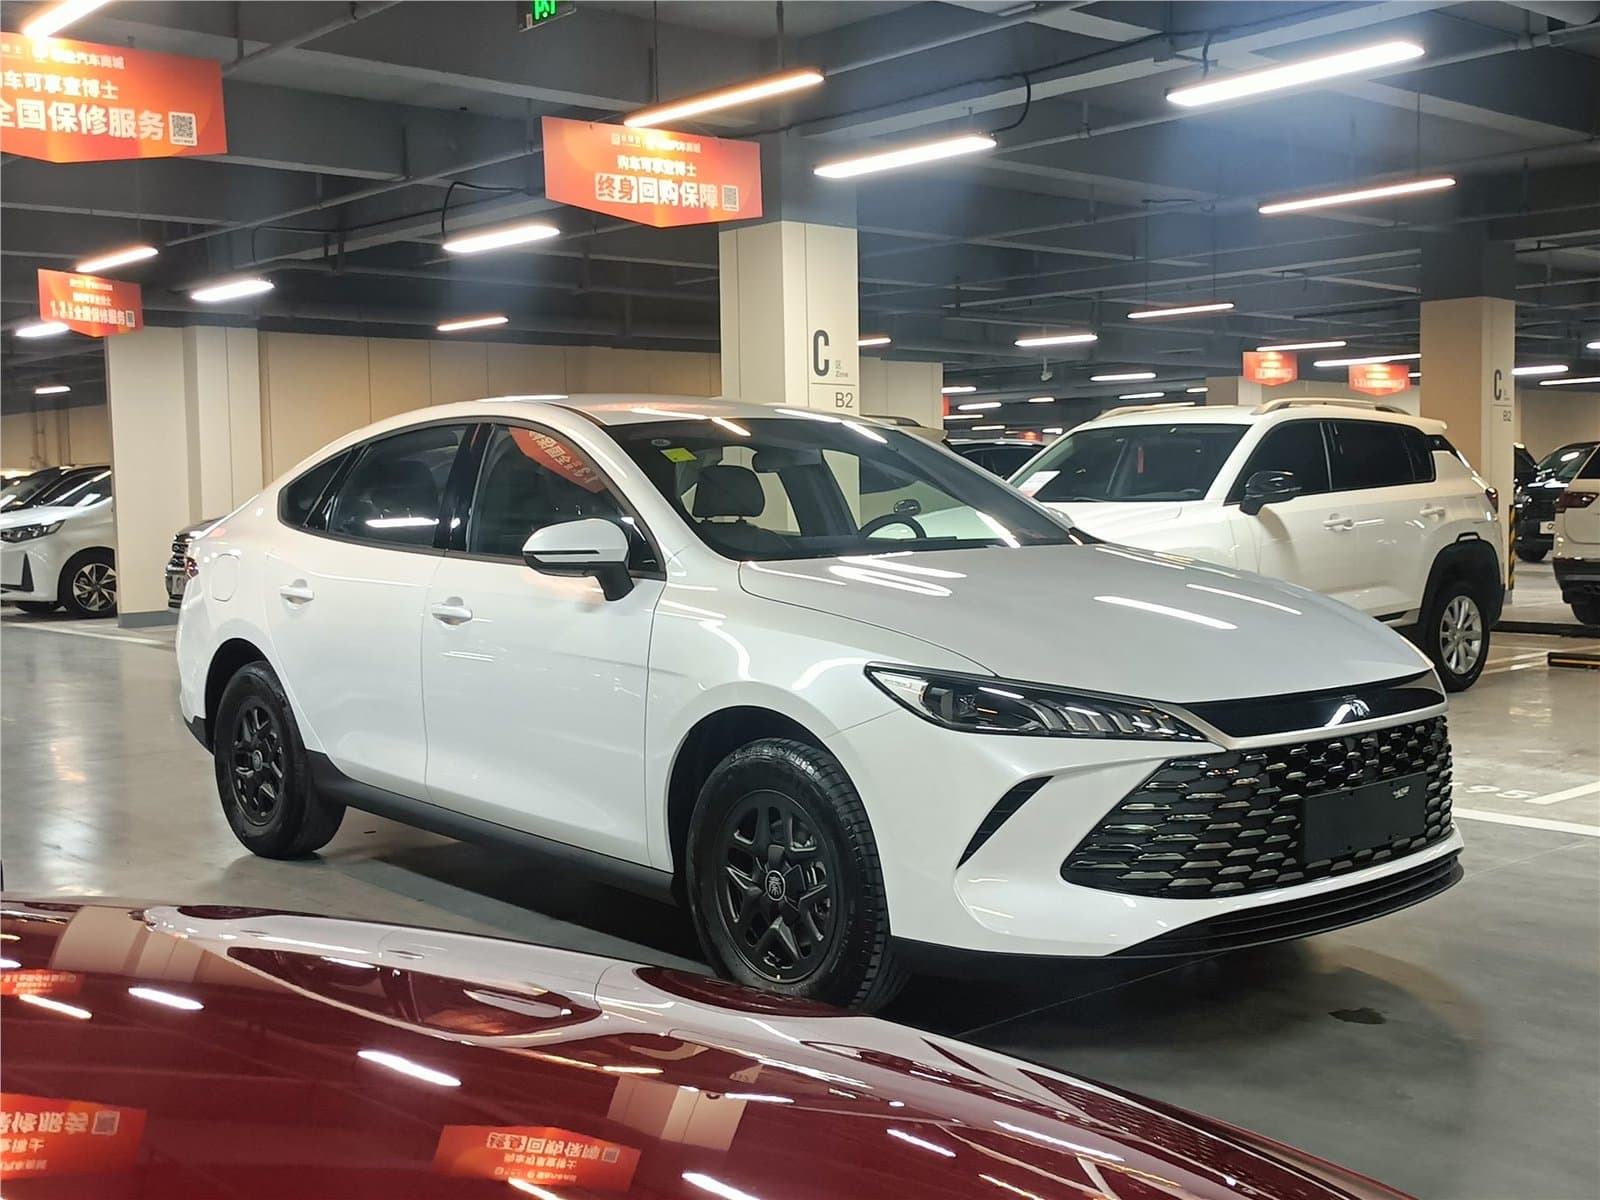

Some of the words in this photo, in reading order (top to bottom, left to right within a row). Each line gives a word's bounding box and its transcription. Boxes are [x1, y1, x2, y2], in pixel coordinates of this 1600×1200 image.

[596, 173, 718, 209] 终身回购保障
[813, 329, 829, 376] C
[835, 392, 853, 408] B2
[1494, 369, 1502, 400] C
